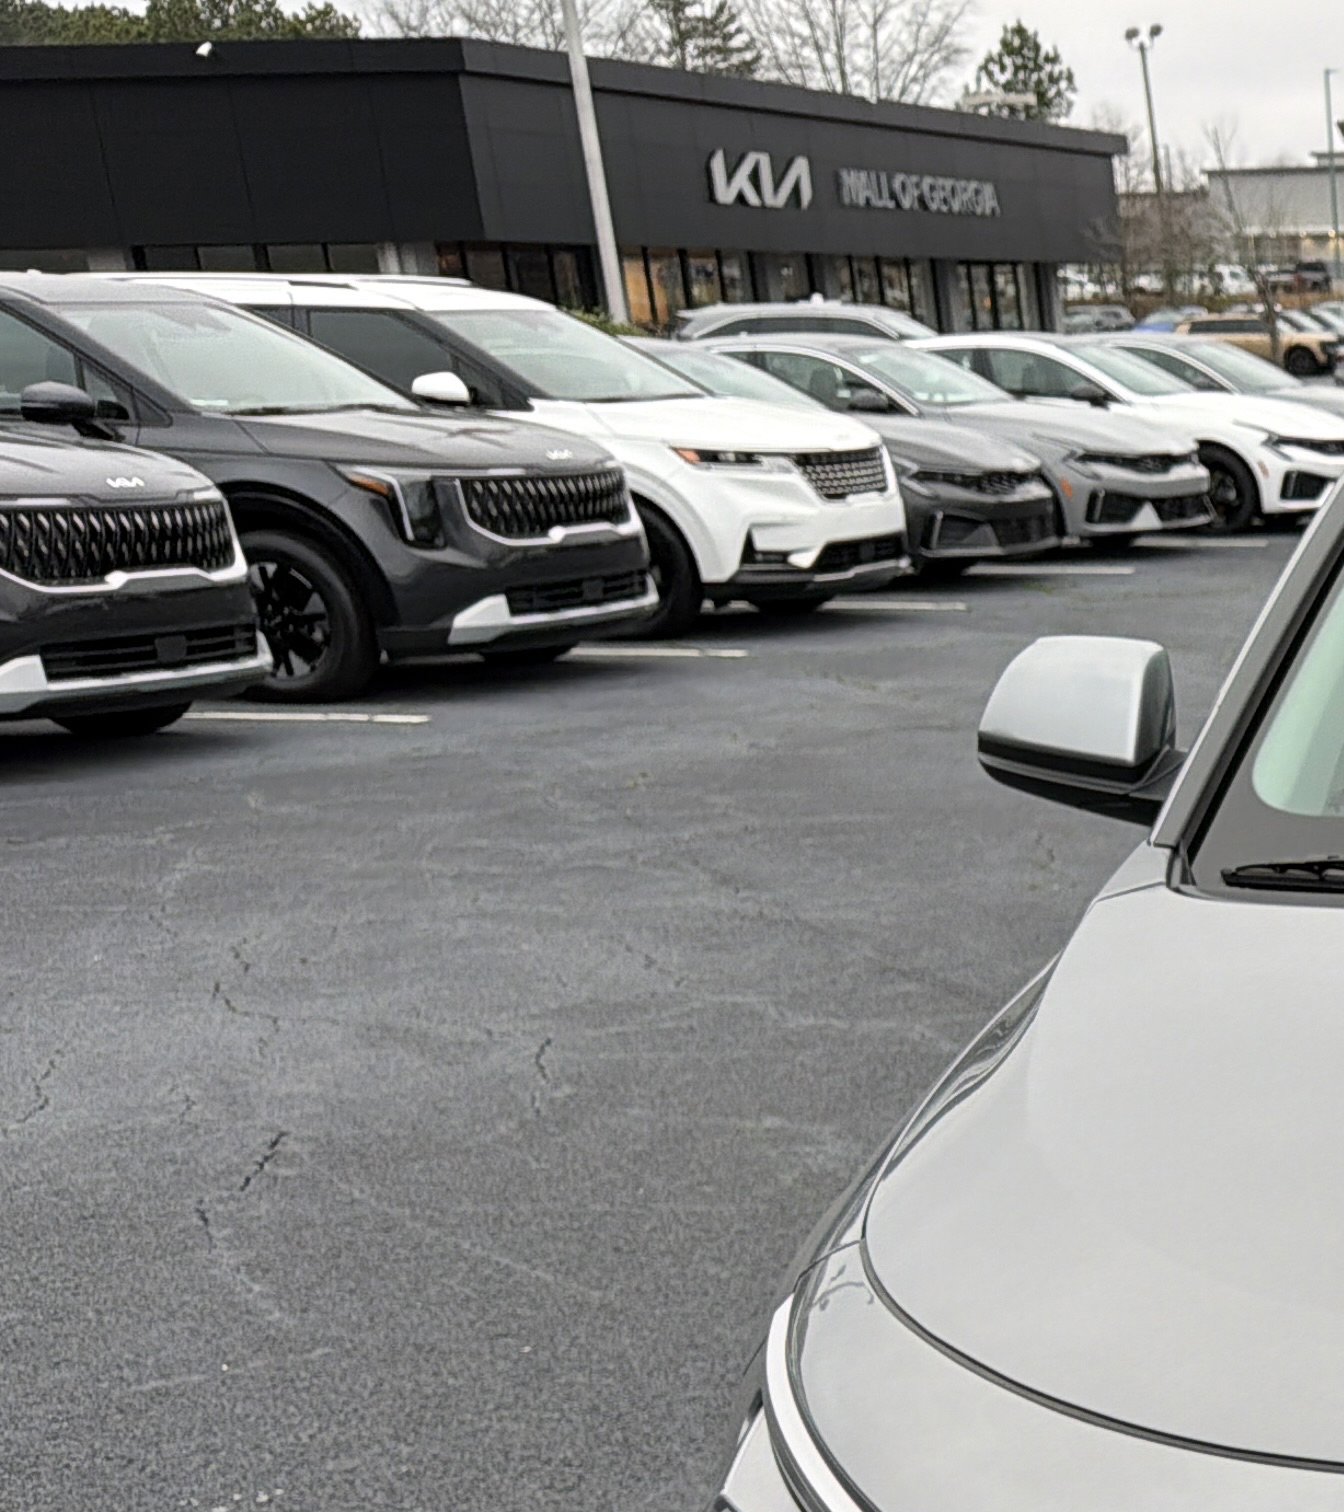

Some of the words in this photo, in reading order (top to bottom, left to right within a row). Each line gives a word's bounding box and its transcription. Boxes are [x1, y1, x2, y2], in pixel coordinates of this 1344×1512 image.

[709, 149, 812, 210] KIA
[893, 172, 921, 211] OF
[922, 175, 1000, 217] GEORGIA
